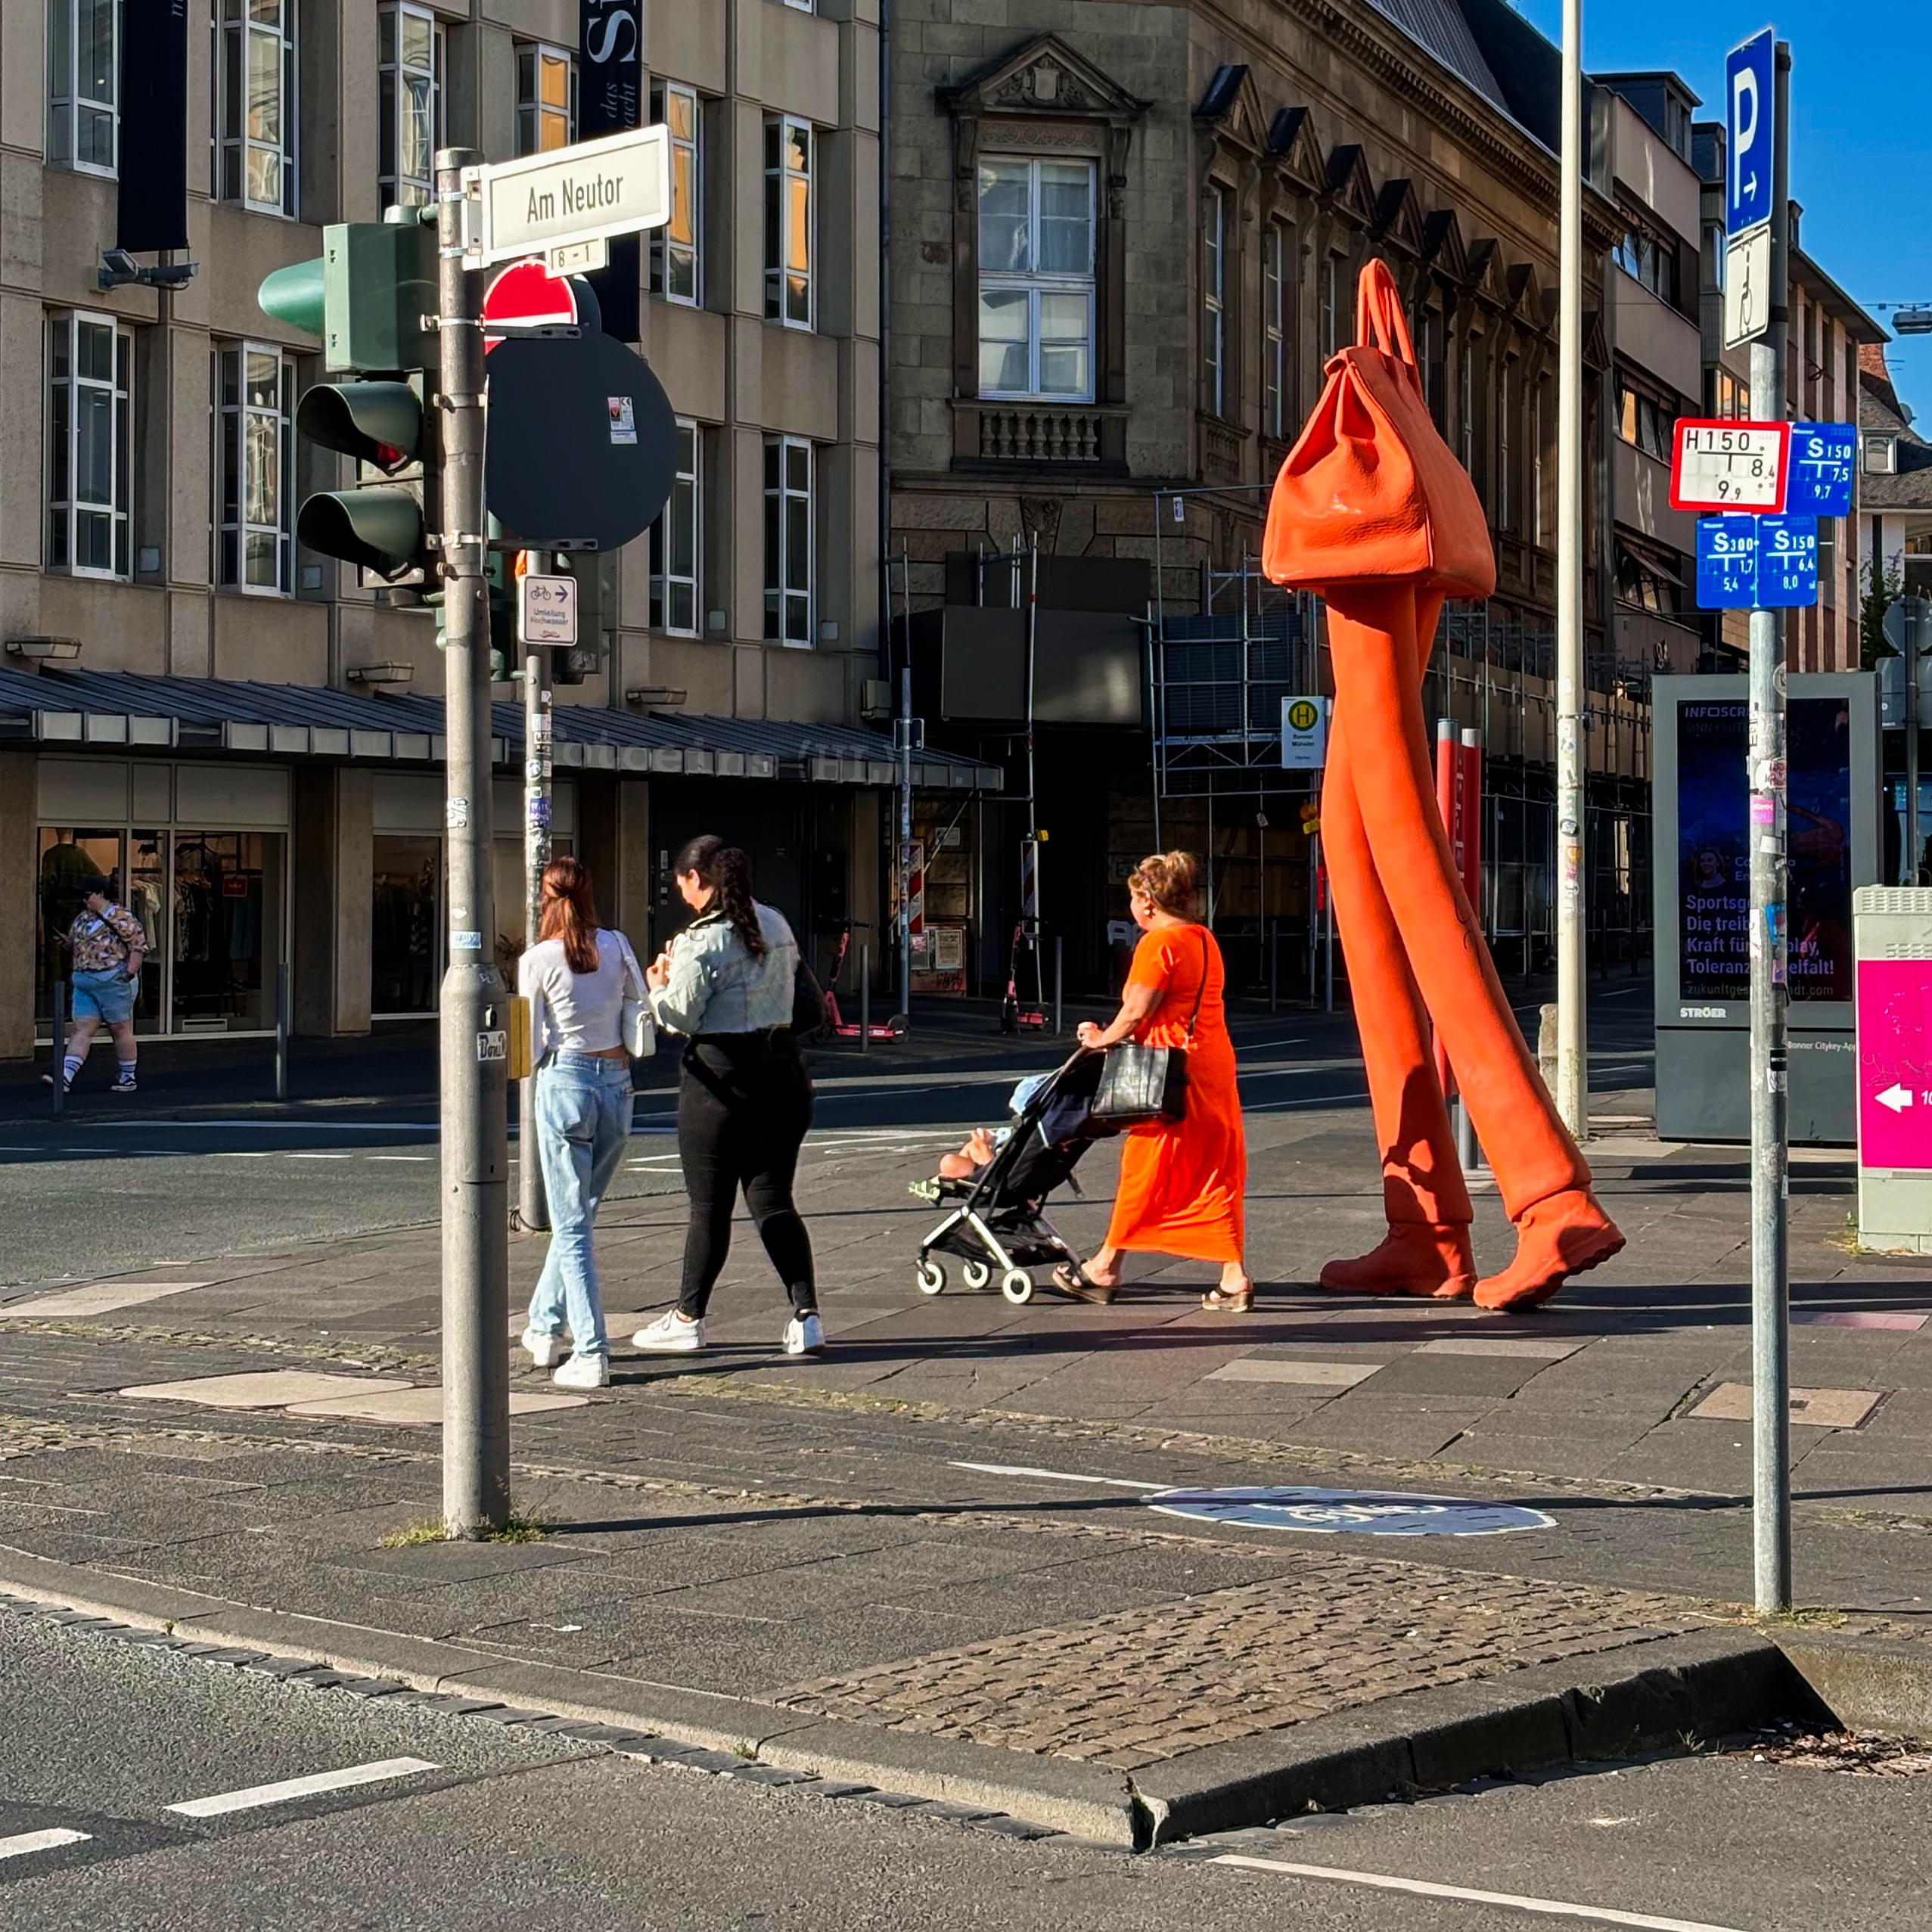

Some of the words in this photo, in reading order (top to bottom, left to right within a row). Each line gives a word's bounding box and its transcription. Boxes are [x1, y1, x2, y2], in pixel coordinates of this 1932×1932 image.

[586, 0, 637, 64] S
[600, 82, 618, 119] das
[618, 82, 636, 130] acht
[1733, 67, 1758, 210] P
[526, 186, 554, 224] Am
[562, 173, 624, 216] Neutor
[1297, 707, 1309, 725] H
[1685, 707, 1750, 717] INFOSCR
[1686, 895, 1750, 912] Sportsg
[1687, 916, 1711, 931] Die
[1687, 938, 1725, 953] Kraft
[1688, 959, 1750, 974] Toleranz
[1788, 959, 1834, 975] elfalt!
[1680, 1007, 1726, 1018] STRÖER
